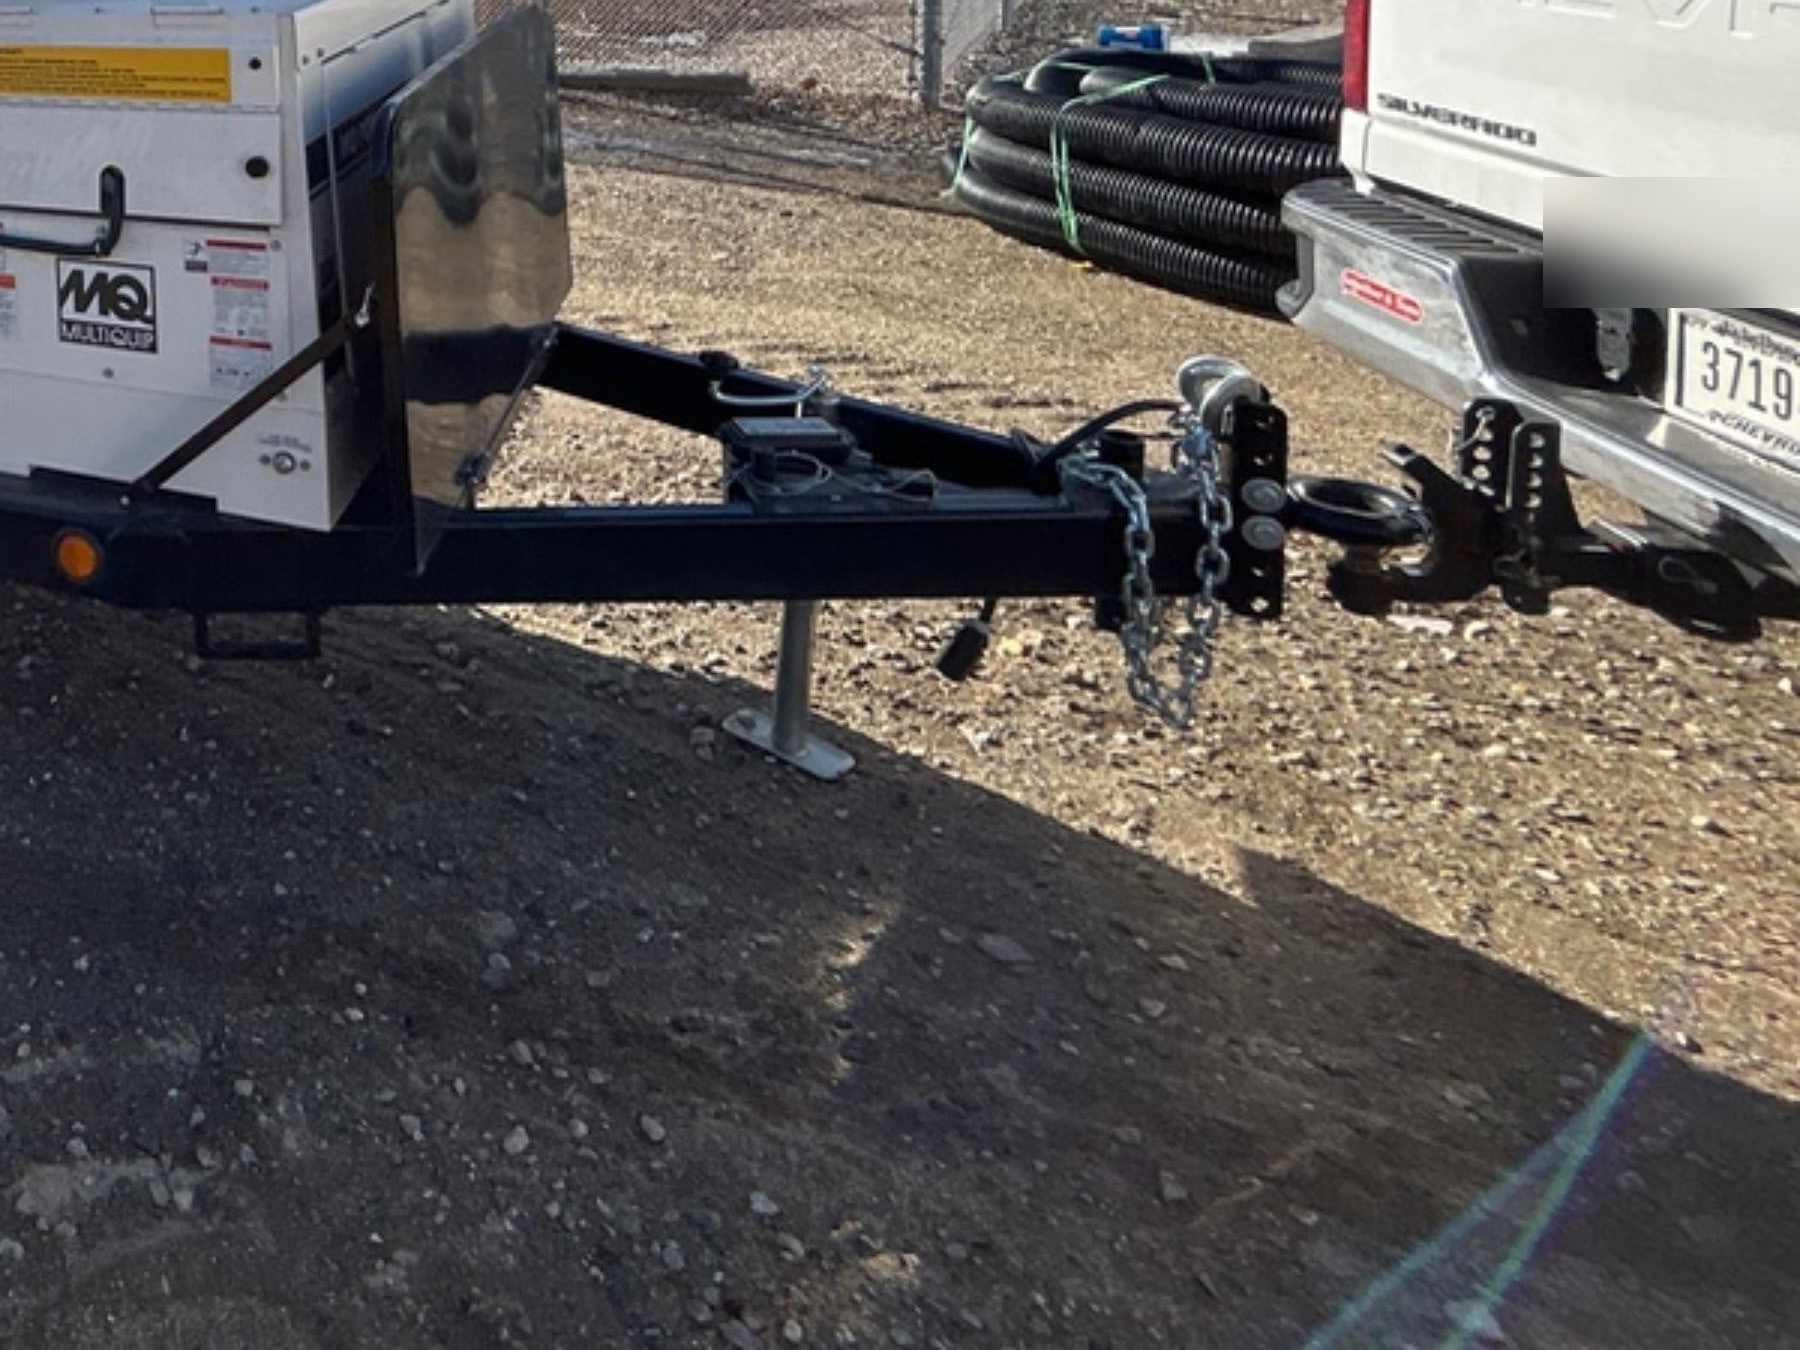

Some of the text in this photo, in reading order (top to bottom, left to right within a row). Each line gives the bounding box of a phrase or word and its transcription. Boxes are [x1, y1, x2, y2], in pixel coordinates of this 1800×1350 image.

[1377, 92, 1537, 147] SILVERADO
[60, 268, 155, 324] MQ
[61, 322, 154, 349] MULTIQUIP
[1702, 341, 1792, 421] 3719
